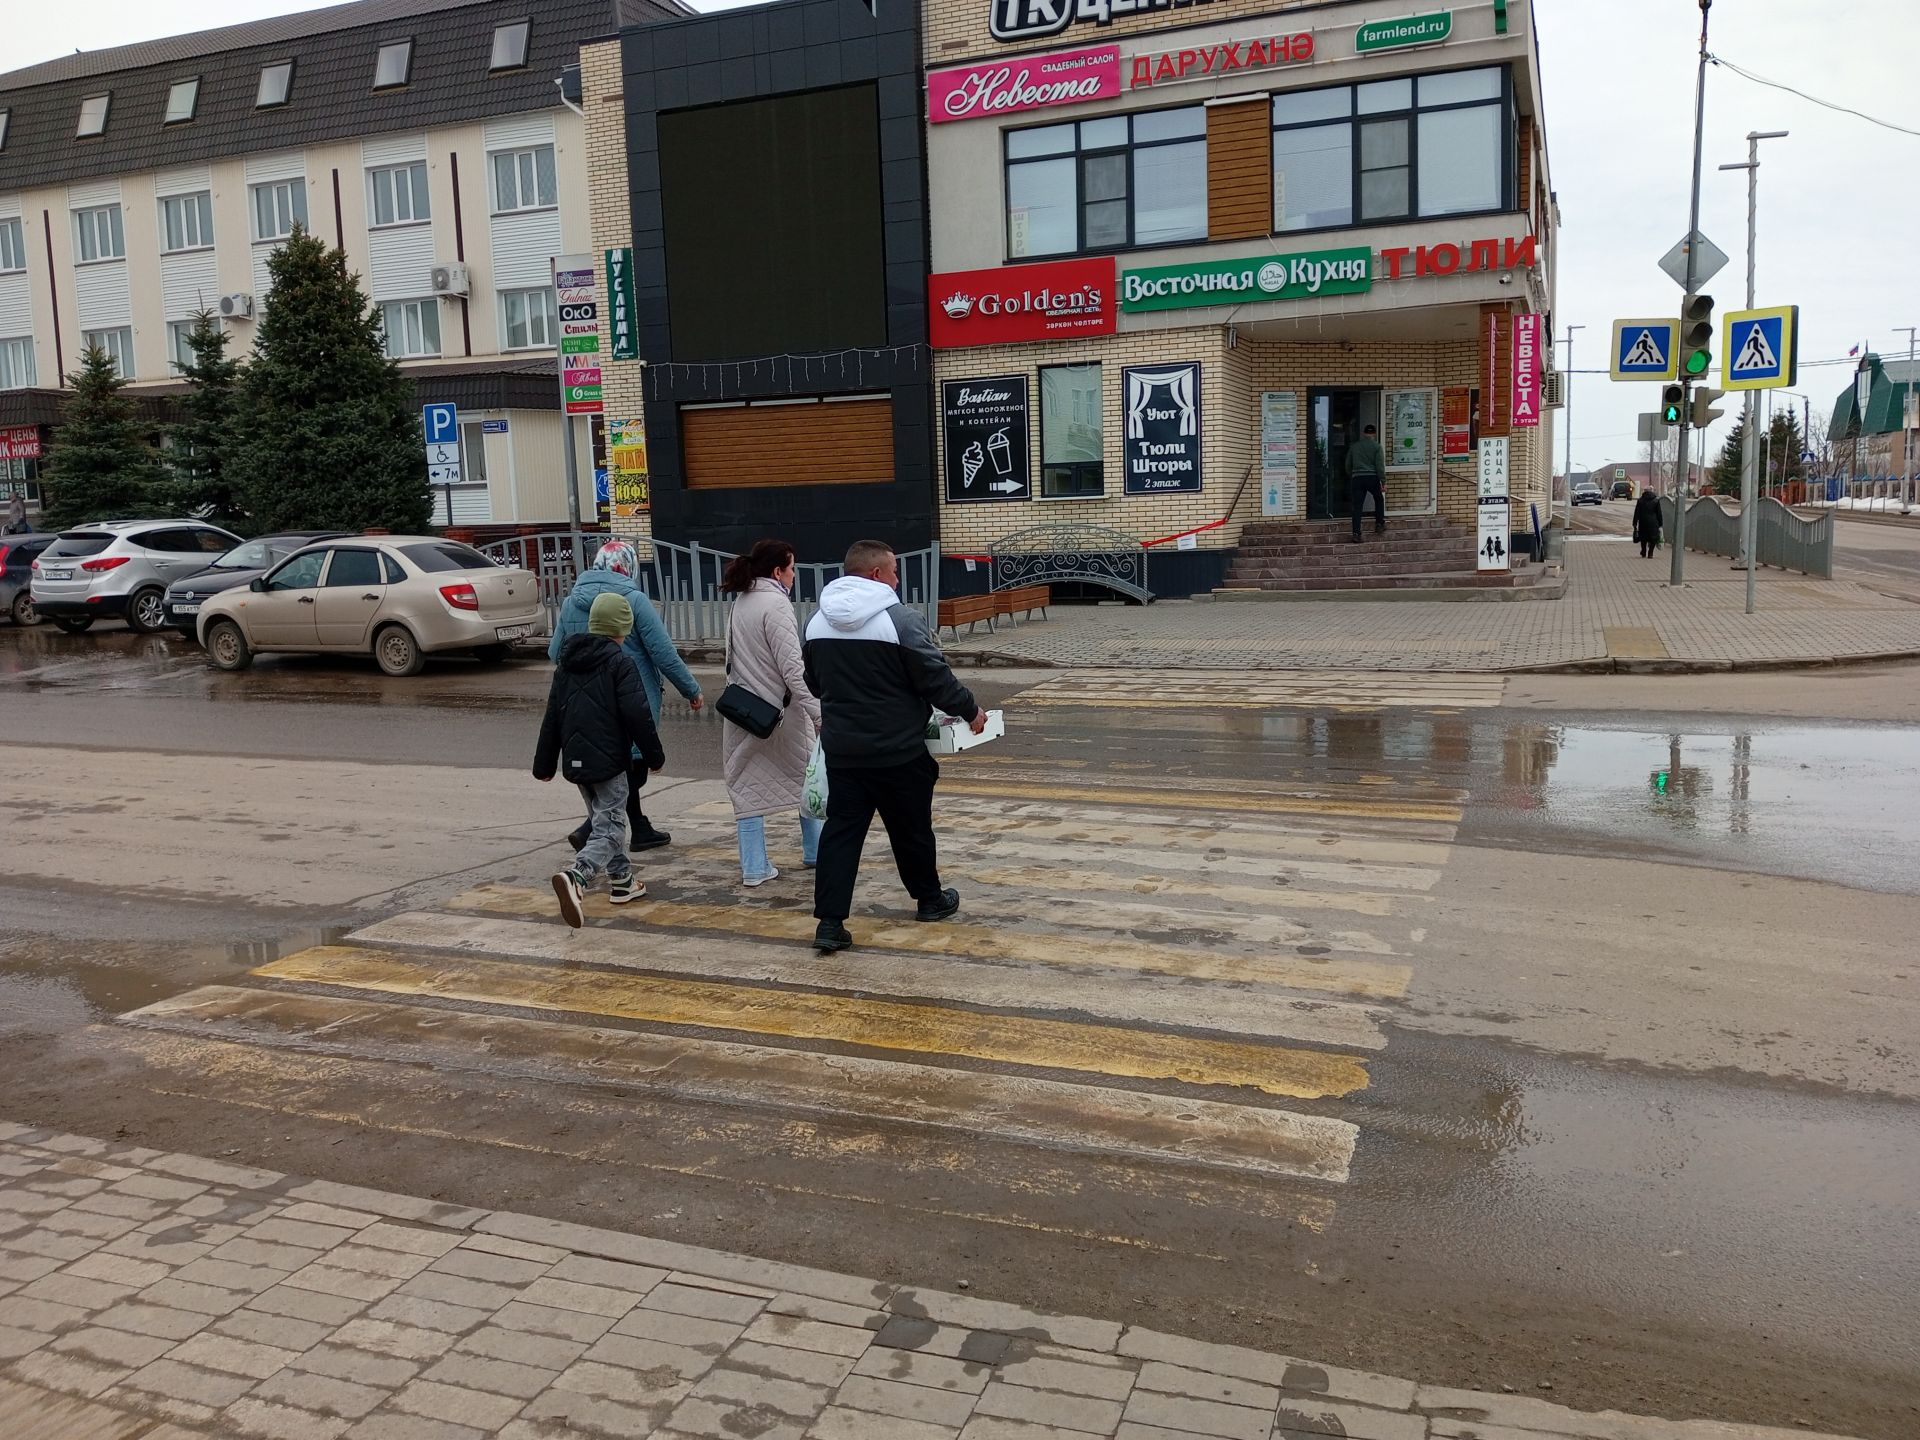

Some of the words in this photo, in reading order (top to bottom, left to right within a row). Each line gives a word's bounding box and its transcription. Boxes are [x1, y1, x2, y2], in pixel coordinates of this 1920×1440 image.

[1363, 22, 1445, 42] farmlend.ru
[1041, 56, 1086, 73] СВАДЕБНЫЙ
[1087, 53, 1114, 66] САЛОН
[1130, 32, 1315, 88] ДАРУХАНӘ
[944, 68, 1102, 116] Невеста
[1380, 236, 1537, 281] ТЮЛИ
[1290, 258, 1366, 293] Кухня
[1125, 270, 1254, 302] Восточная
[978, 284, 1102, 316] Golden's
[1516, 316, 1534, 416] НЕВЕСТА
[957, 387, 1012, 406] Bastian
[947, 408, 976, 416] МЯГКОЕ
[978, 405, 1024, 413] МОРОЖЕНОЕ
[1146, 408, 1177, 421] Уют
[968, 416, 1011, 425] КОКТЕЙЛИ
[10, 429, 37, 444] ЦЕНЫ
[11, 443, 39, 457] НИЖЕ
[1139, 441, 1186, 456] Тюли
[1132, 459, 1193, 475] Шторы
[1483, 441, 1491, 494] МАССАЖ
[616, 484, 647, 500] КОФЕ
[1145, 479, 1151, 488] 2
[1152, 479, 1181, 487] этаж
